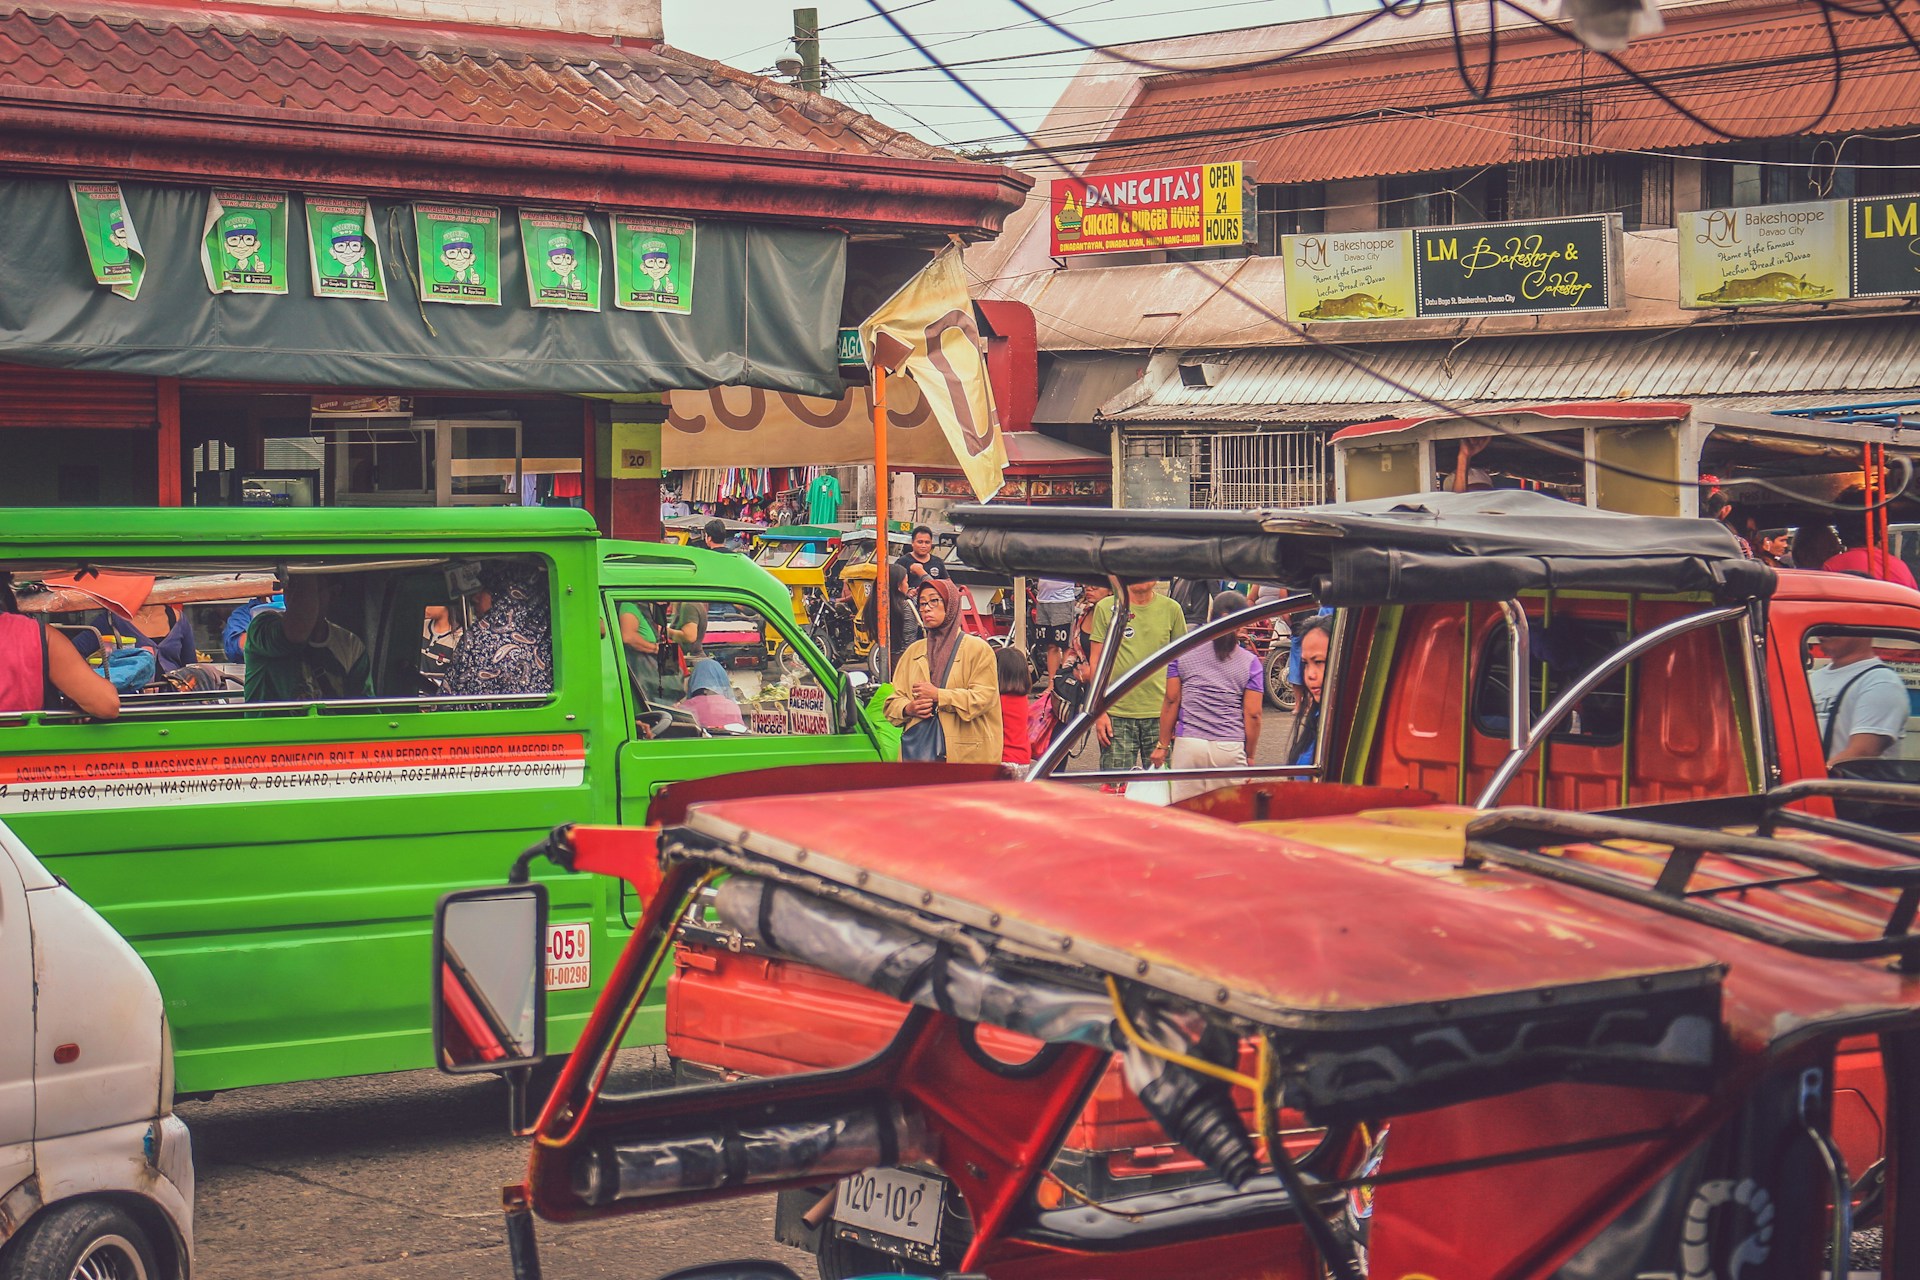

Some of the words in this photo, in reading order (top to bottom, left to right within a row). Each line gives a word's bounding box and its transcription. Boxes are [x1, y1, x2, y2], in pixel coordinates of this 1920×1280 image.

[1210, 165, 1235, 188] OPEN
[1086, 172, 1200, 208] DANECITA'S
[1216, 192, 1227, 214] 24
[1083, 212, 1118, 236] CHICKEN
[1122, 212, 1130, 234] &
[1132, 208, 1168, 232] BURGER
[1171, 206, 1200, 229] HOUSE
[1206, 218, 1238, 240] HOURS
[1696, 210, 1742, 248] LM
[1746, 212, 1824, 226] Bakeshoppe
[1865, 202, 1917, 239] LM
[1760, 228, 1785, 236] Davao
[1789, 226, 1805, 235] City
[1296, 238, 1332, 271] LM
[1334, 239, 1394, 252] Bakeshoppe
[1367, 252, 1380, 261] City
[1718, 252, 1742, 262] Home
[1744, 246, 1752, 258] of
[1753, 243, 1764, 253] the
[1767, 240, 1795, 250] Famous
[1427, 238, 1458, 262] LM
[1460, 234, 1560, 284] Bakeshop
[1565, 243, 1578, 260] &
[1722, 265, 1749, 277] Lechon
[1750, 258, 1775, 271] Bread
[1785, 252, 1810, 263] Davao
[1313, 274, 1332, 283] Home
[1334, 269, 1340, 281] of
[1340, 268, 1349, 277] the
[1352, 264, 1372, 274] Famous
[1317, 286, 1338, 297] Lechon
[1338, 281, 1358, 292] Bread
[1365, 275, 1385, 284] Davao
[1522, 270, 1592, 306] Cakeshop
[1505, 294, 1515, 303] City
[630, 456, 644, 466] 20
[1055, 630, 1067, 641] 30
[790, 699, 824, 711] PALENGKE
[146, 757, 208, 774] MAGSAYSAY
[374, 750, 392, 763] SAN
[397, 748, 428, 762] PEDRO
[450, 747, 469, 759] DON
[23, 788, 57, 802] DATU
[60, 786, 100, 800] BAGO,
[105, 783, 156, 797] PICHON,
[160, 777, 245, 793] WASHINGTON,
[251, 777, 261, 789] Q.
[266, 773, 332, 788] BOLEVARD,
[336, 773, 345, 785] L.
[350, 770, 396, 784] GARCIA,
[401, 766, 466, 781] ROSEMARIE
[470, 764, 504, 781] (BACK
[508, 764, 521, 776] TO
[524, 763, 567, 779] ORIGIN)
[546, 930, 585, 960] -059
